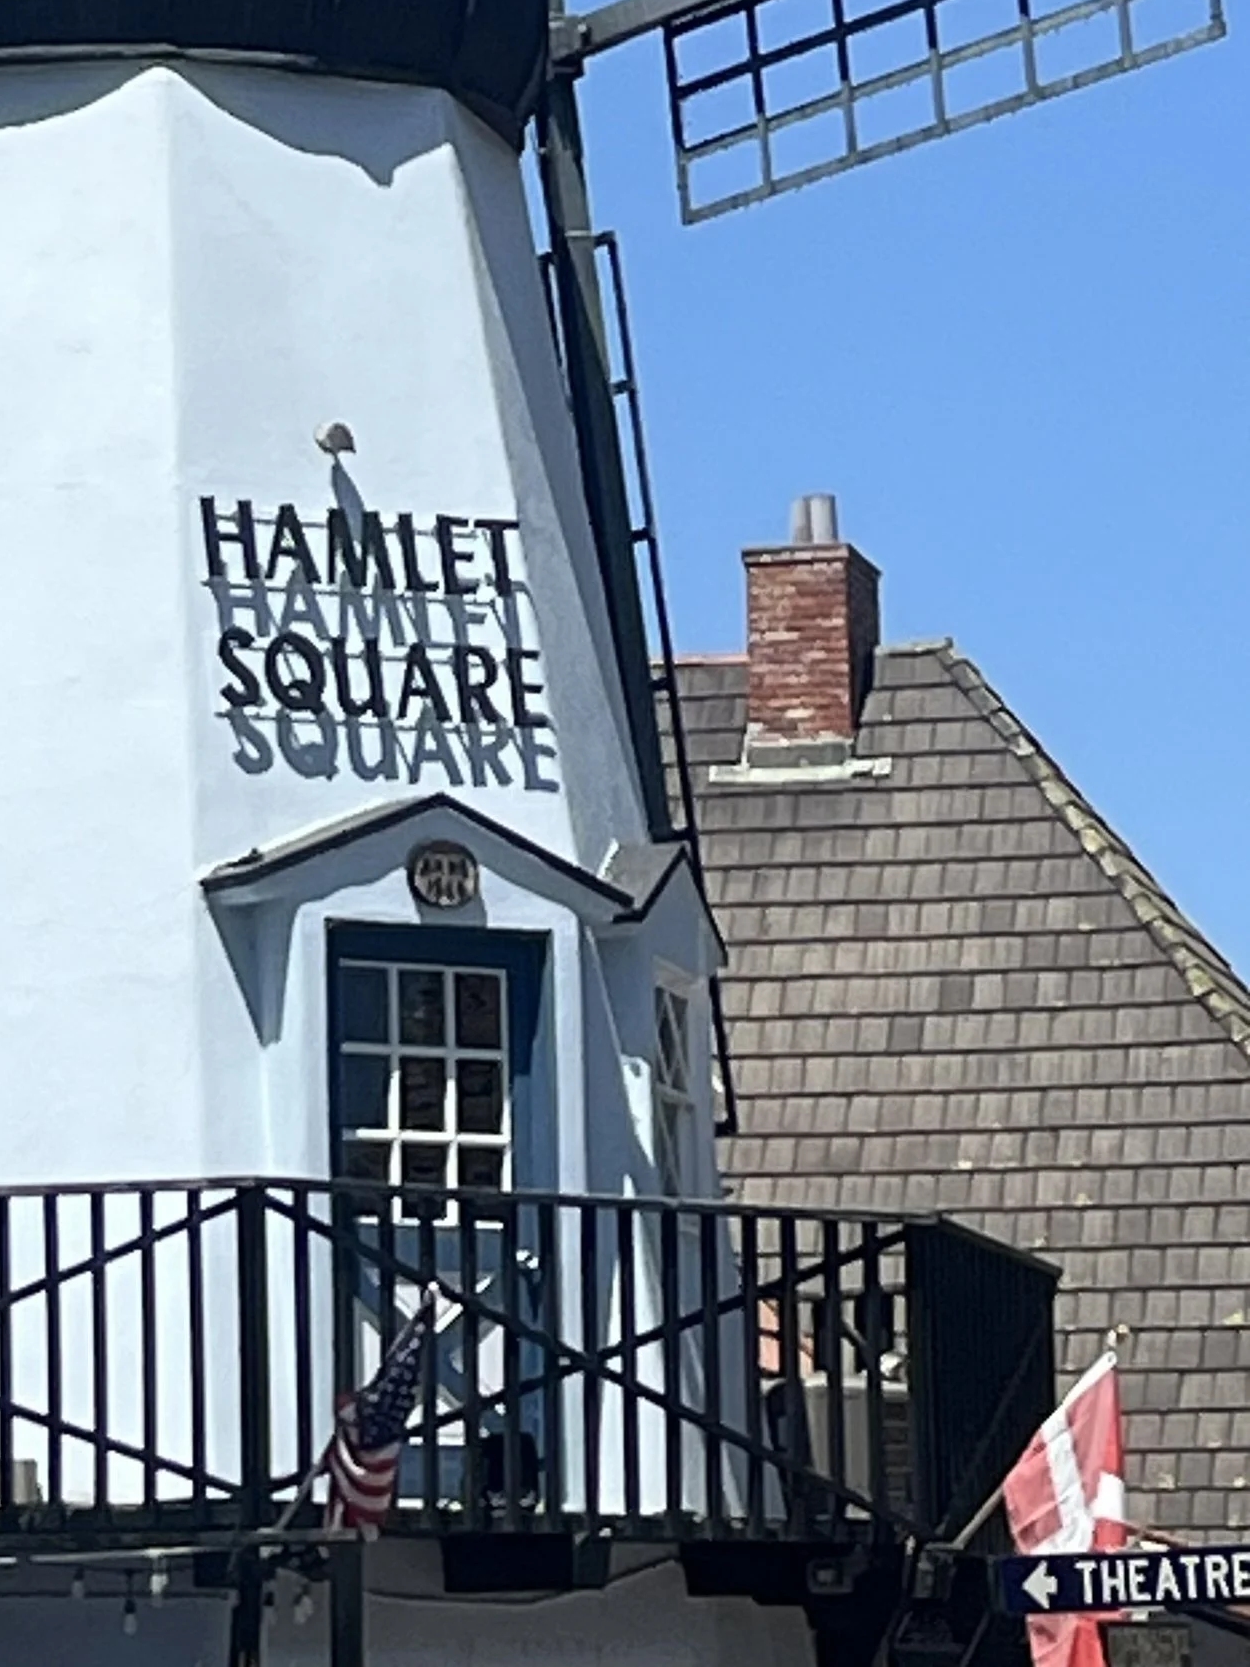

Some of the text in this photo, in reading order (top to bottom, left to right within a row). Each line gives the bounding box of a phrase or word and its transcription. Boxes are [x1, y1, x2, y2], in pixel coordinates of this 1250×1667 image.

[200, 495, 519, 596] HAMLET
[219, 625, 549, 727] SQUARE
[1074, 1551, 1250, 1604] THEATRE
